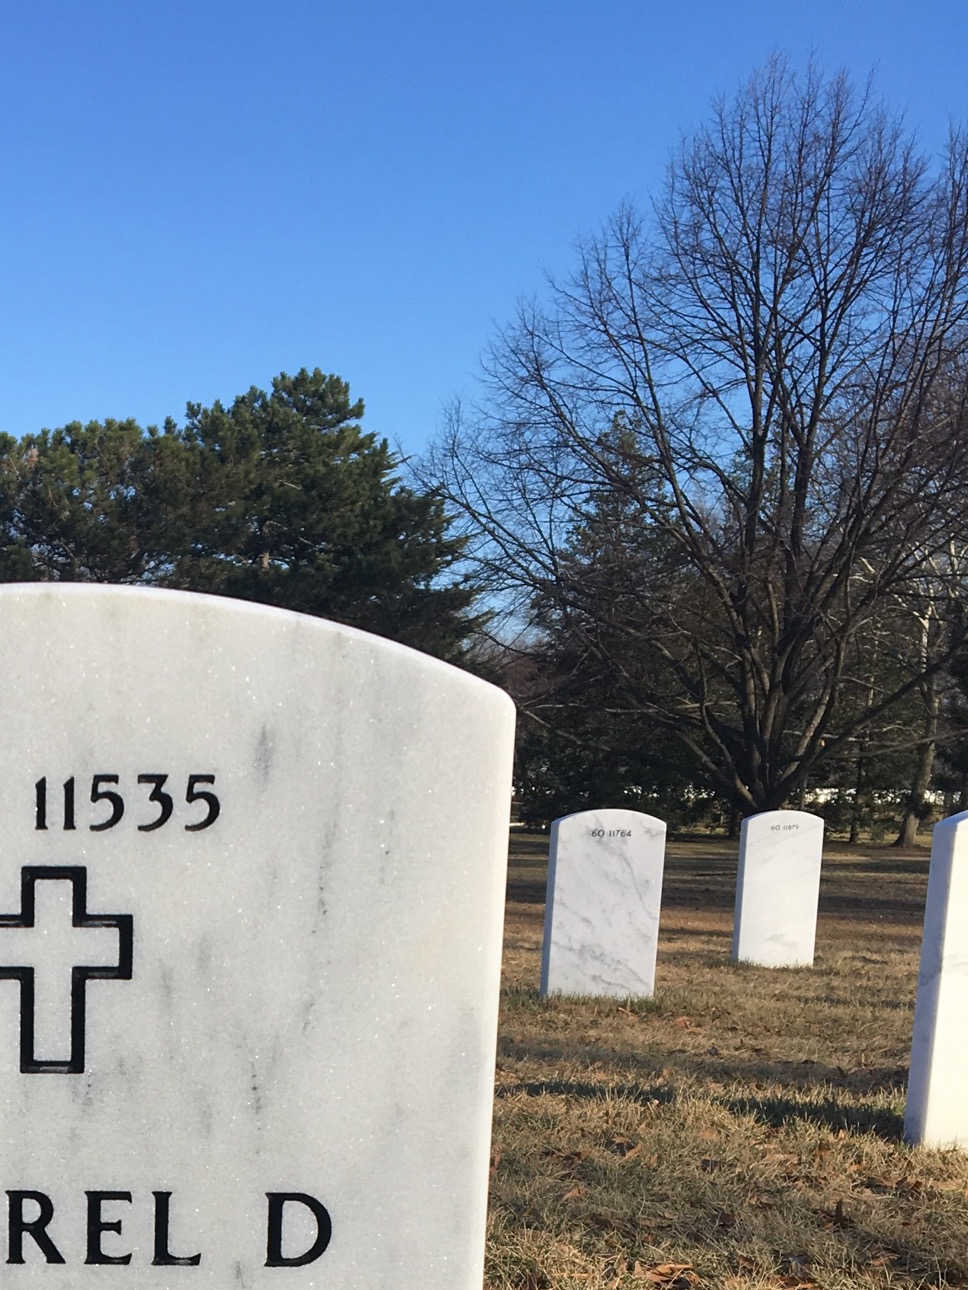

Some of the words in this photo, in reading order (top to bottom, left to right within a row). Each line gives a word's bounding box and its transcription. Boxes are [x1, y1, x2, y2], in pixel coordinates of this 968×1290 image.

[34, 773, 221, 833] 11535
[591, 828, 605, 837] 60
[263, 1191, 333, 1268] D
